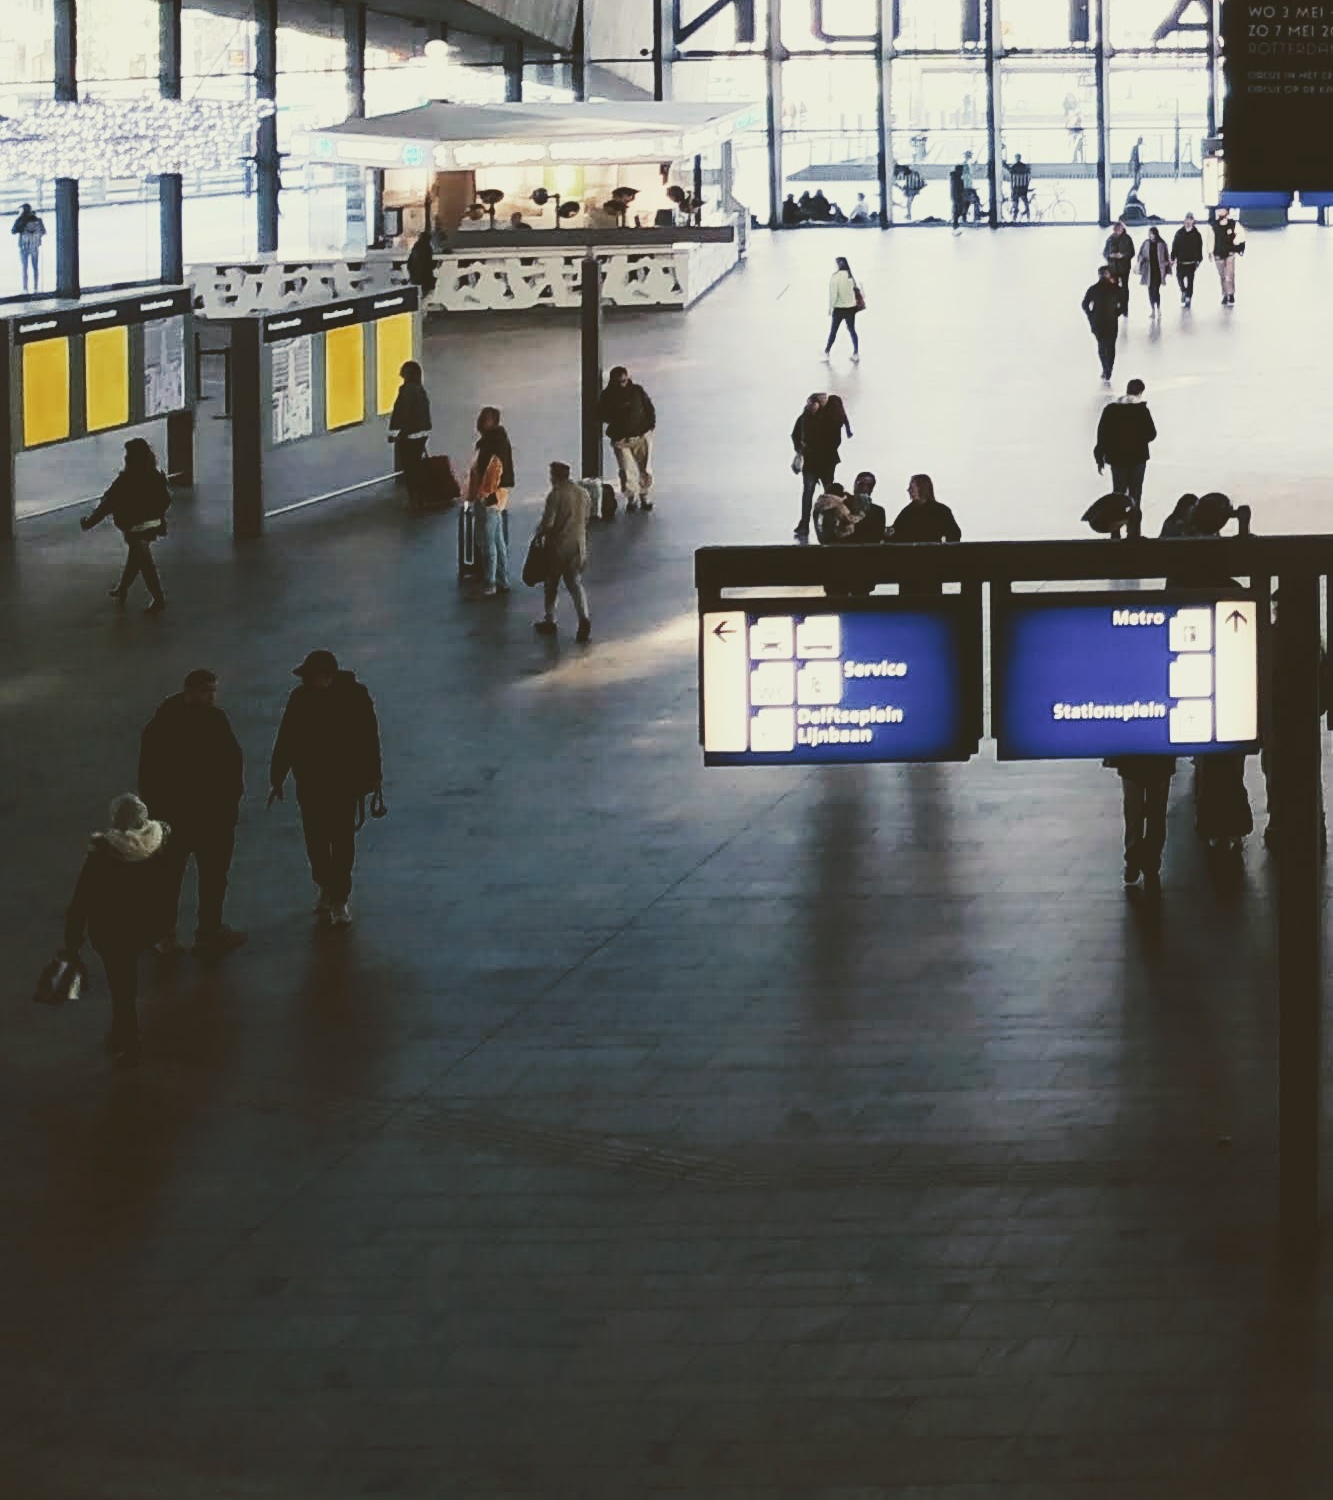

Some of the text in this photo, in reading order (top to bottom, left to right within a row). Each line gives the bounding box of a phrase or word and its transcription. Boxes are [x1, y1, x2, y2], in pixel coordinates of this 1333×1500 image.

[1248, 5, 1276, 19] WO
[1282, 6, 1289, 18] 3
[1296, 6, 1324, 19] MEI
[1248, 24, 1269, 38] ZO
[1275, 25, 1282, 38] 7
[1288, 25, 1315, 38] MEI
[1112, 609, 1165, 626] Metro
[843, 660, 908, 678] Service
[1053, 701, 1166, 722] Stationsplein
[797, 727, 873, 747] Lijnbaan
